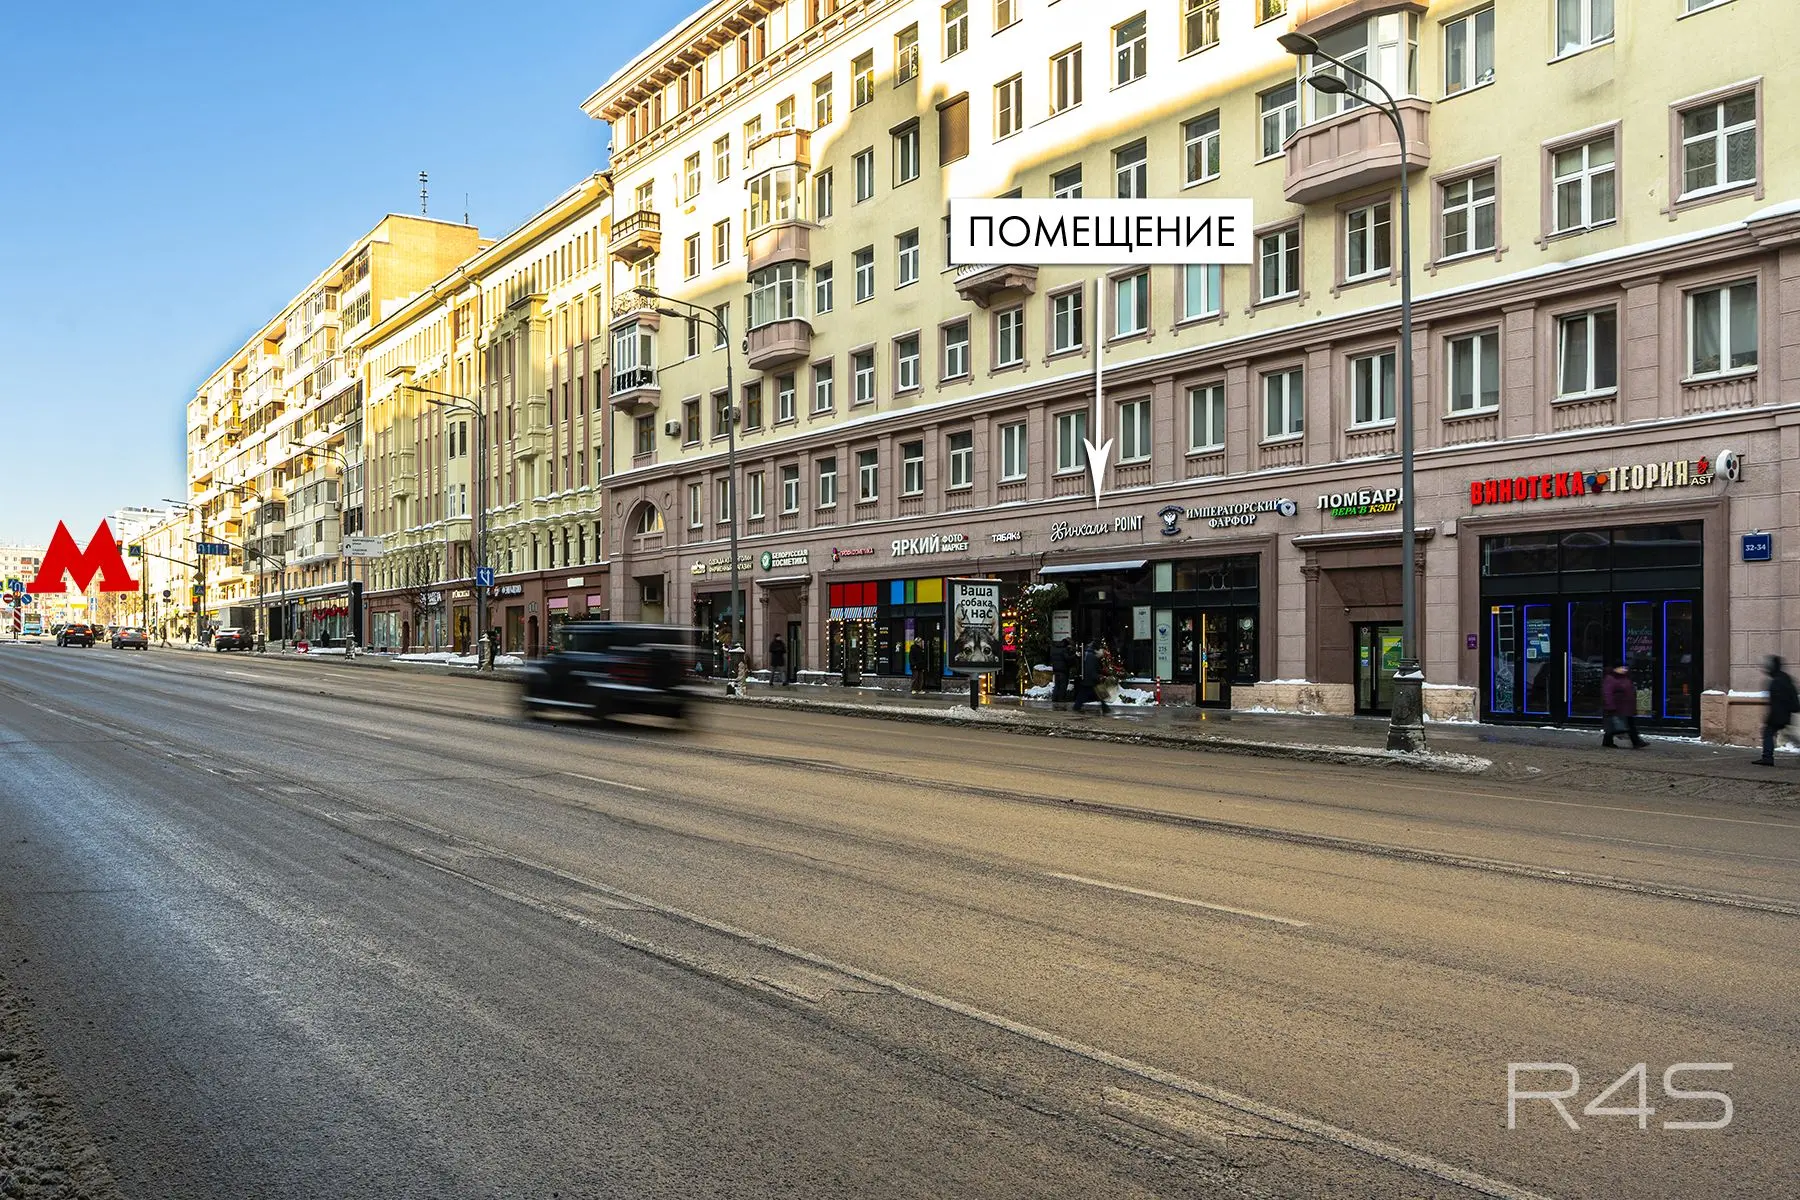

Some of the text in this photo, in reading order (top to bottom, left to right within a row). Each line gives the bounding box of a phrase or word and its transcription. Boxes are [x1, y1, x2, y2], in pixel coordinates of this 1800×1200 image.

[1471, 459, 1689, 505] ВИНОТЕКА ТЕОРИЯ
[1690, 474, 1713, 486] AST
[1331, 507, 1357, 517] ВЕРА
[1369, 502, 1397, 513] КЭШ
[1115, 515, 1144, 532] POINT
[1208, 514, 1257, 528] ФАРФОР
[892, 532, 940, 557] ЯРКИЙ
[942, 534, 963, 543] ФОТО
[942, 542, 969, 551] МАРКЕТ
[772, 549, 808, 560] БЕЛОРУССКАЯ
[772, 556, 808, 567] КОСМЕТИКА
[961, 585, 993, 597] Ваша
[961, 598, 993, 607] собака
[961, 609, 993, 620] у нас
